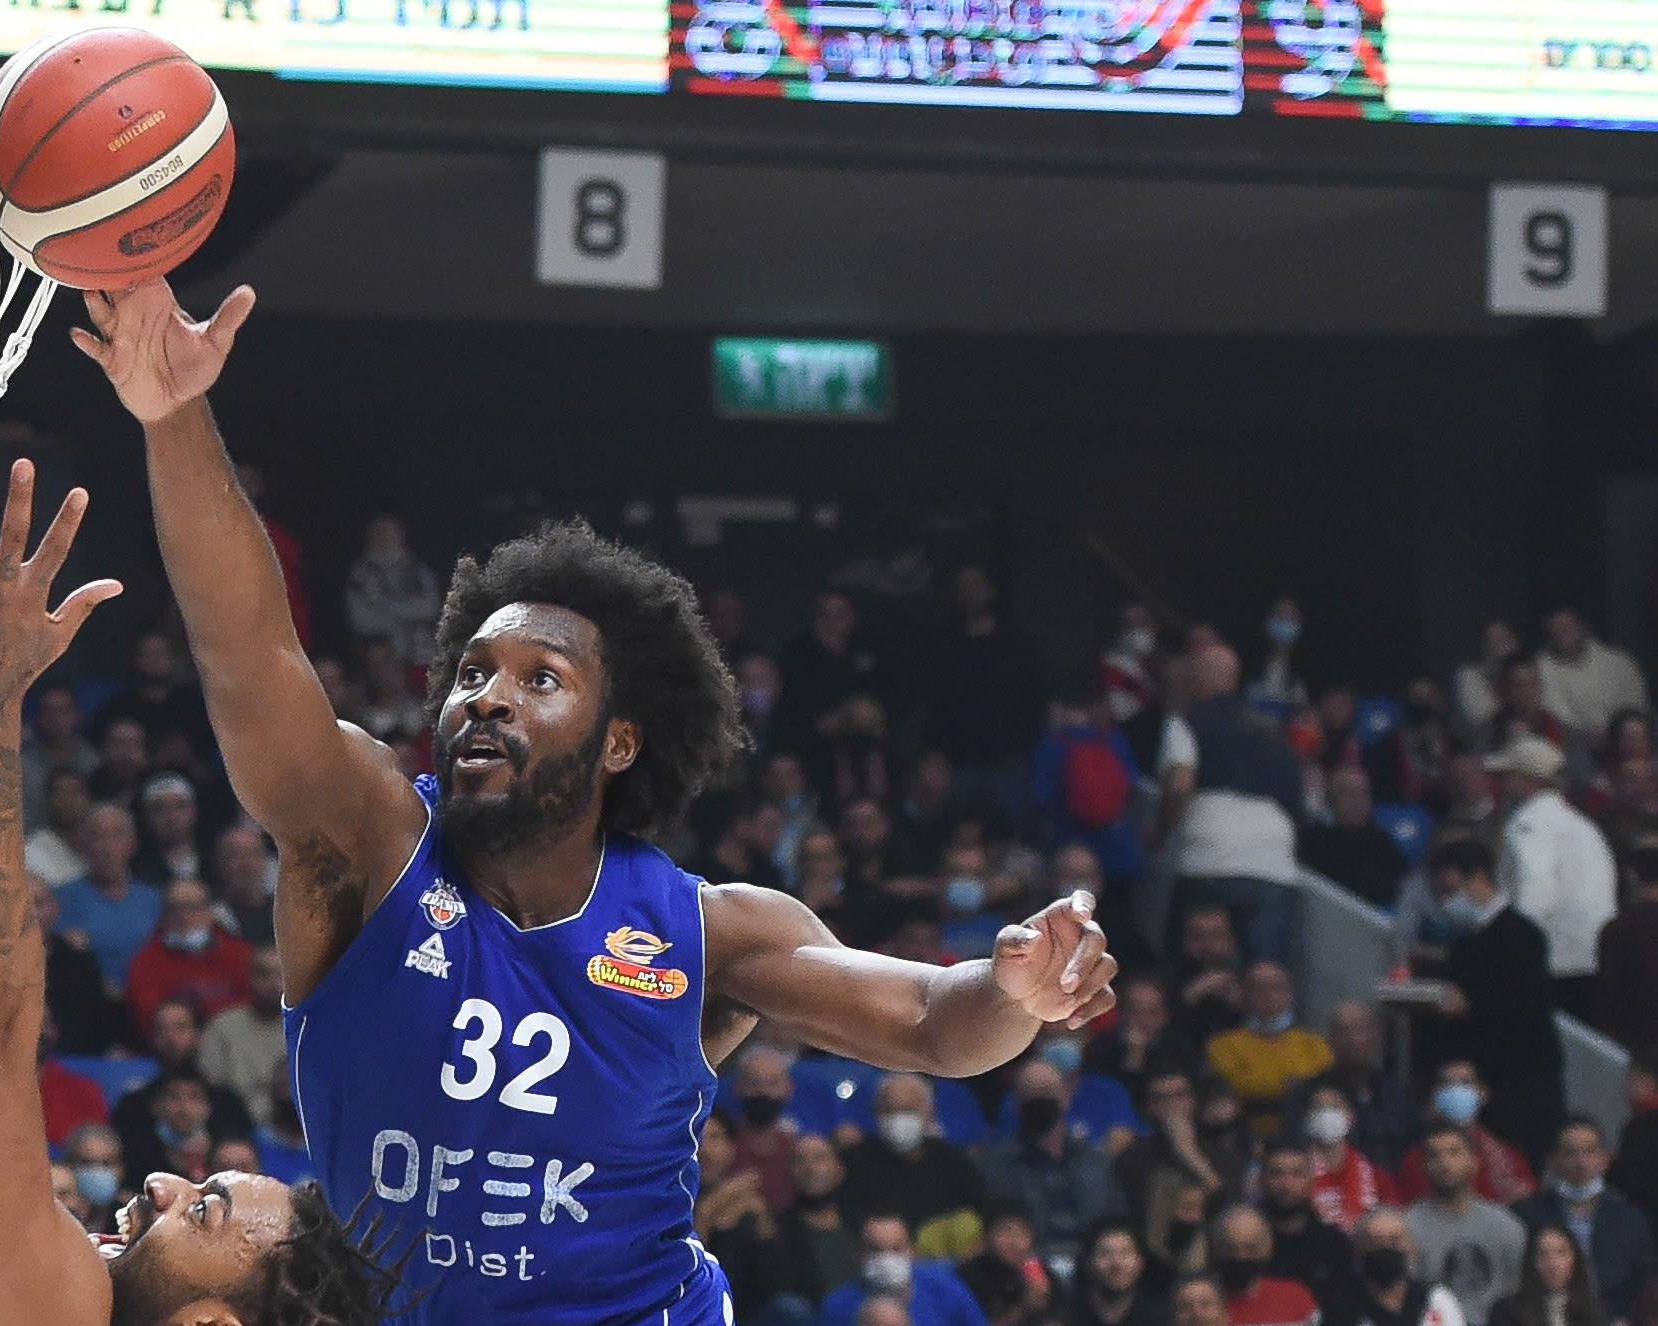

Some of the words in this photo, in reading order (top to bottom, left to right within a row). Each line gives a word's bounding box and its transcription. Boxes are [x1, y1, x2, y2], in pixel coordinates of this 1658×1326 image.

[572, 177, 627, 260] 8
[1521, 208, 1574, 289] 9
[405, 949, 453, 980] PEAK
[599, 964, 658, 992] Winner
[441, 998, 570, 1115] 32
[372, 1129, 595, 1227] OFEK
[426, 1233, 549, 1280] Dist.
